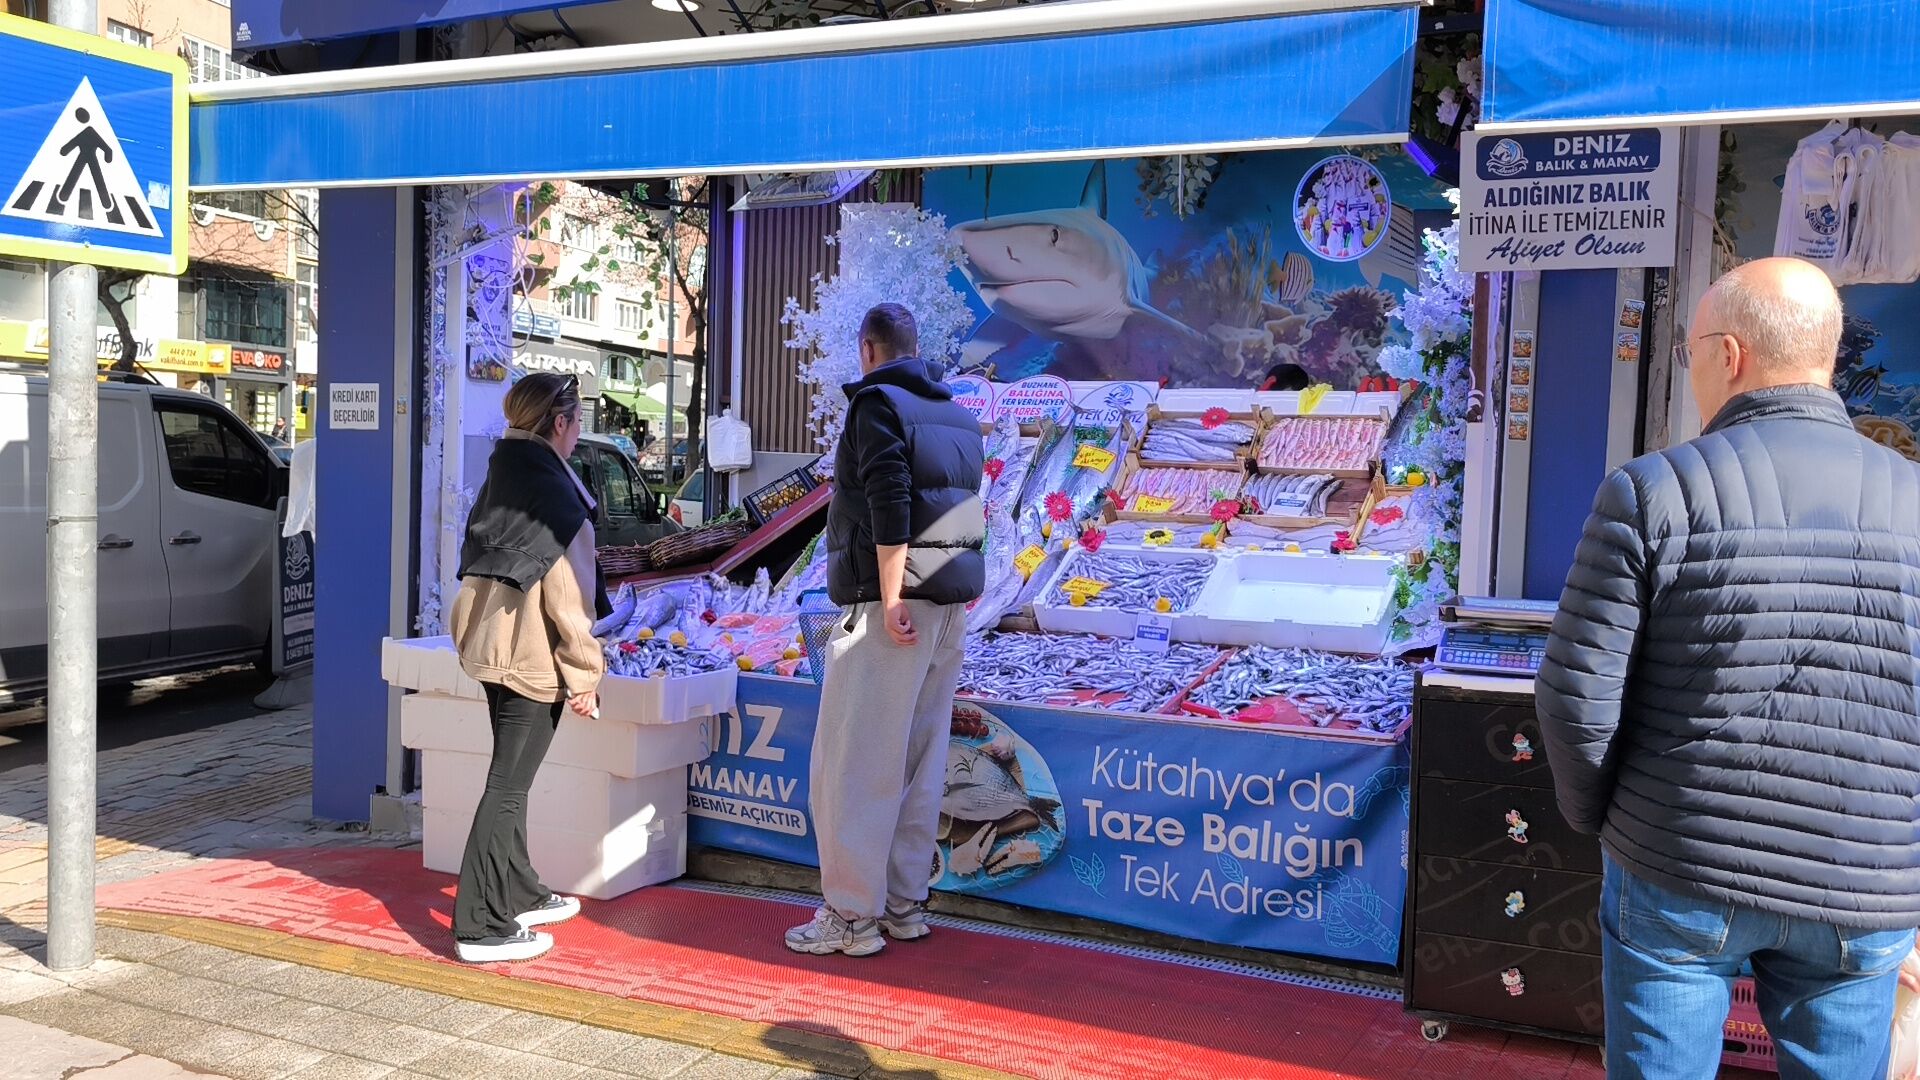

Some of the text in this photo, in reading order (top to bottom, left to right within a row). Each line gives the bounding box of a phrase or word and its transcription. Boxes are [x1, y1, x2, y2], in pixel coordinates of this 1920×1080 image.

[1536, 155, 1650, 172] BALIK & MANAV
[1484, 180, 1650, 208] ALDIĞINIZ BALIK
[1469, 205, 1665, 235] İTİNA İLE TEMİZLENİR
[1486, 233, 1647, 264] Afiyet Olsun
[333, 388, 377, 403] KREDİ KARTI
[334, 408, 375, 424] GEÇERLİDİR
[1014, 407, 1041, 415] ADRES
[690, 763, 798, 803] MANAV
[740, 806, 801, 829] AÇIKTIR
[1082, 798, 1185, 847] Taze
[1203, 813, 1363, 879] Balığın
[1120, 854, 1322, 920] Tek Adresi
